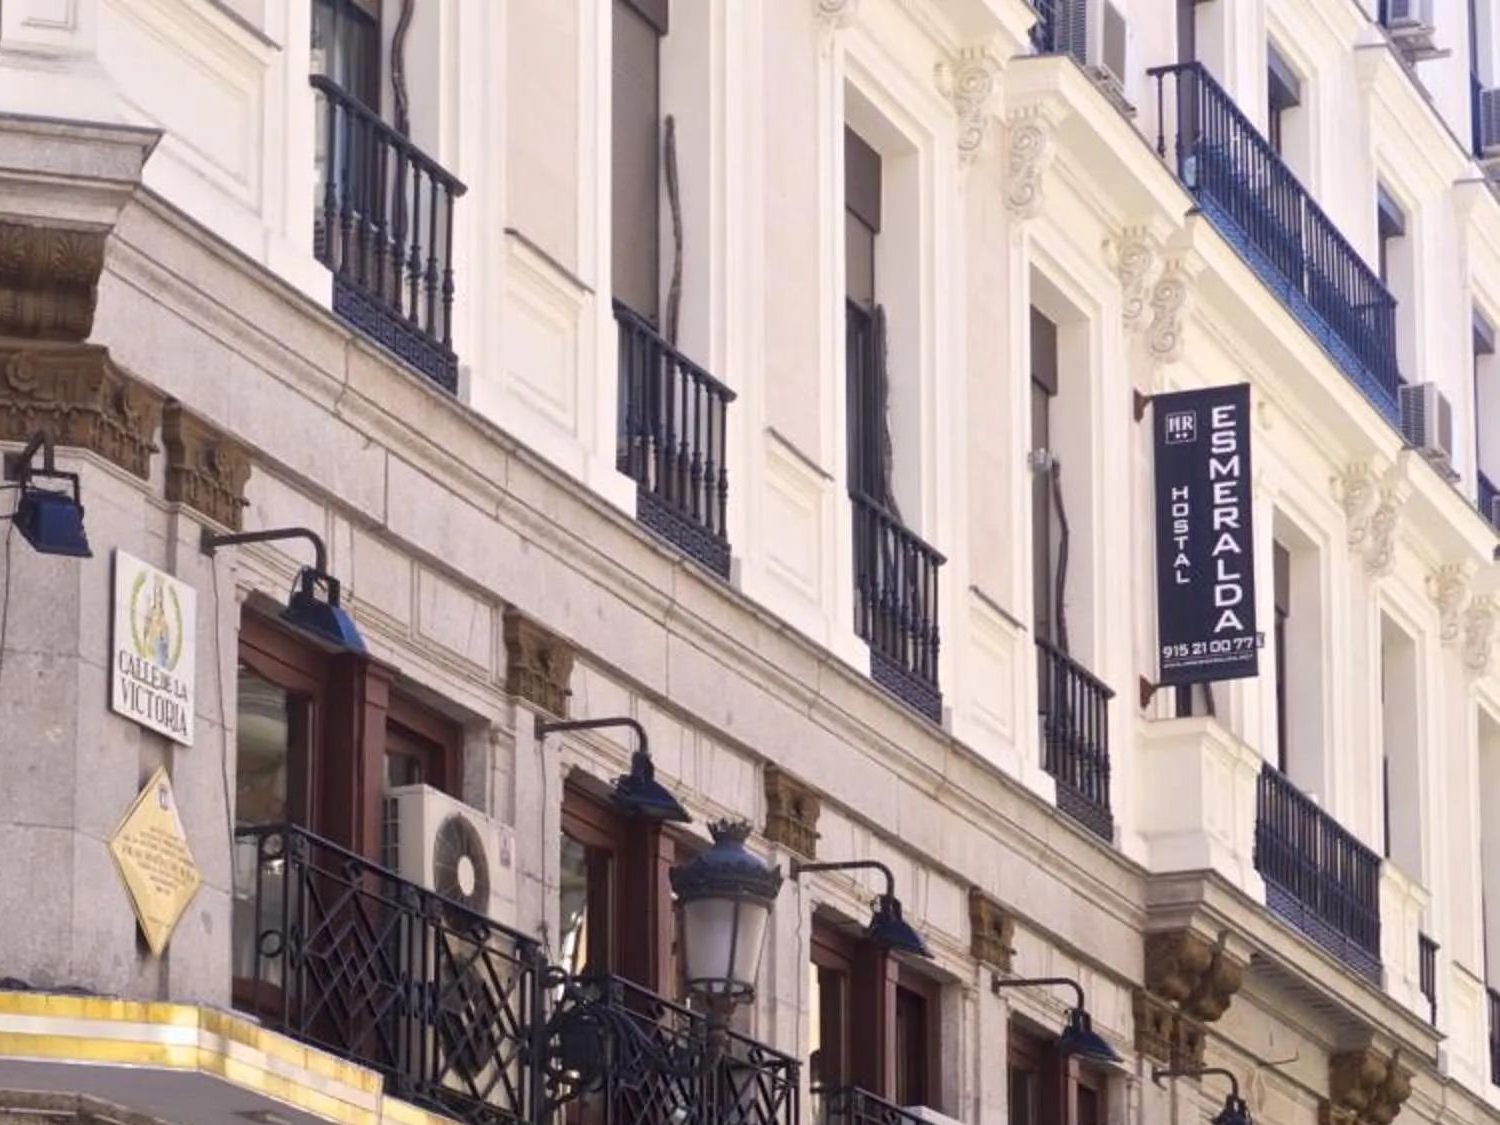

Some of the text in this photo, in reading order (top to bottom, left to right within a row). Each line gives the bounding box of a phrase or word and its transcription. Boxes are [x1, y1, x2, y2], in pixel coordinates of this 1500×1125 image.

[1171, 486, 1191, 584] HOSTAL
[1208, 404, 1244, 633] ESMERALDA
[118, 649, 163, 690] CALLE
[173, 678, 189, 703] LA
[1162, 636, 1254, 660] 915 21 00 77
[120, 676, 189, 737] VICTORIA
